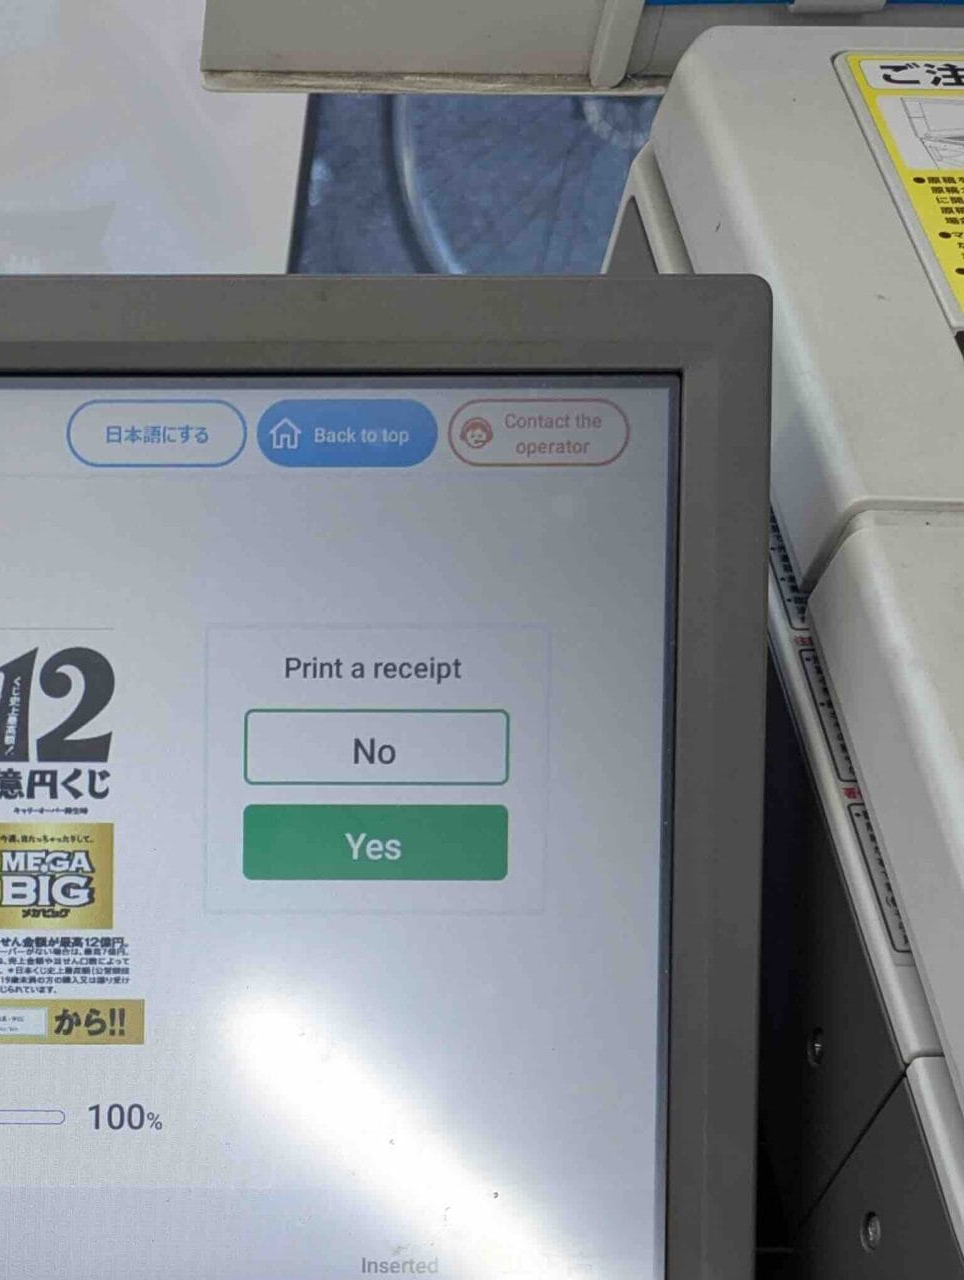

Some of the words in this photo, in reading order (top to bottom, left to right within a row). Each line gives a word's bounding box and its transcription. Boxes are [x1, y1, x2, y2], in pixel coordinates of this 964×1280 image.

[504, 412, 568, 430] Contact
[576, 412, 603, 430] the
[105, 425, 210, 446] 日本語にする
[314, 427, 357, 444] Back
[361, 428, 378, 444] to
[381, 429, 411, 449] top
[515, 439, 591, 459] operator
[284, 657, 343, 680] Print
[350, 664, 366, 680] a
[373, 657, 462, 685] receipt
[352, 737, 397, 765] No
[344, 833, 402, 861] Yes
[0, 850, 96, 873] MEGA
[0, 873, 96, 908] BIG
[22, 908, 71, 919] メガビッグ
[54, 1007, 126, 1037] から!!
[89, 1103, 163, 1131] 100%
[361, 1256, 439, 1275] Inserted
